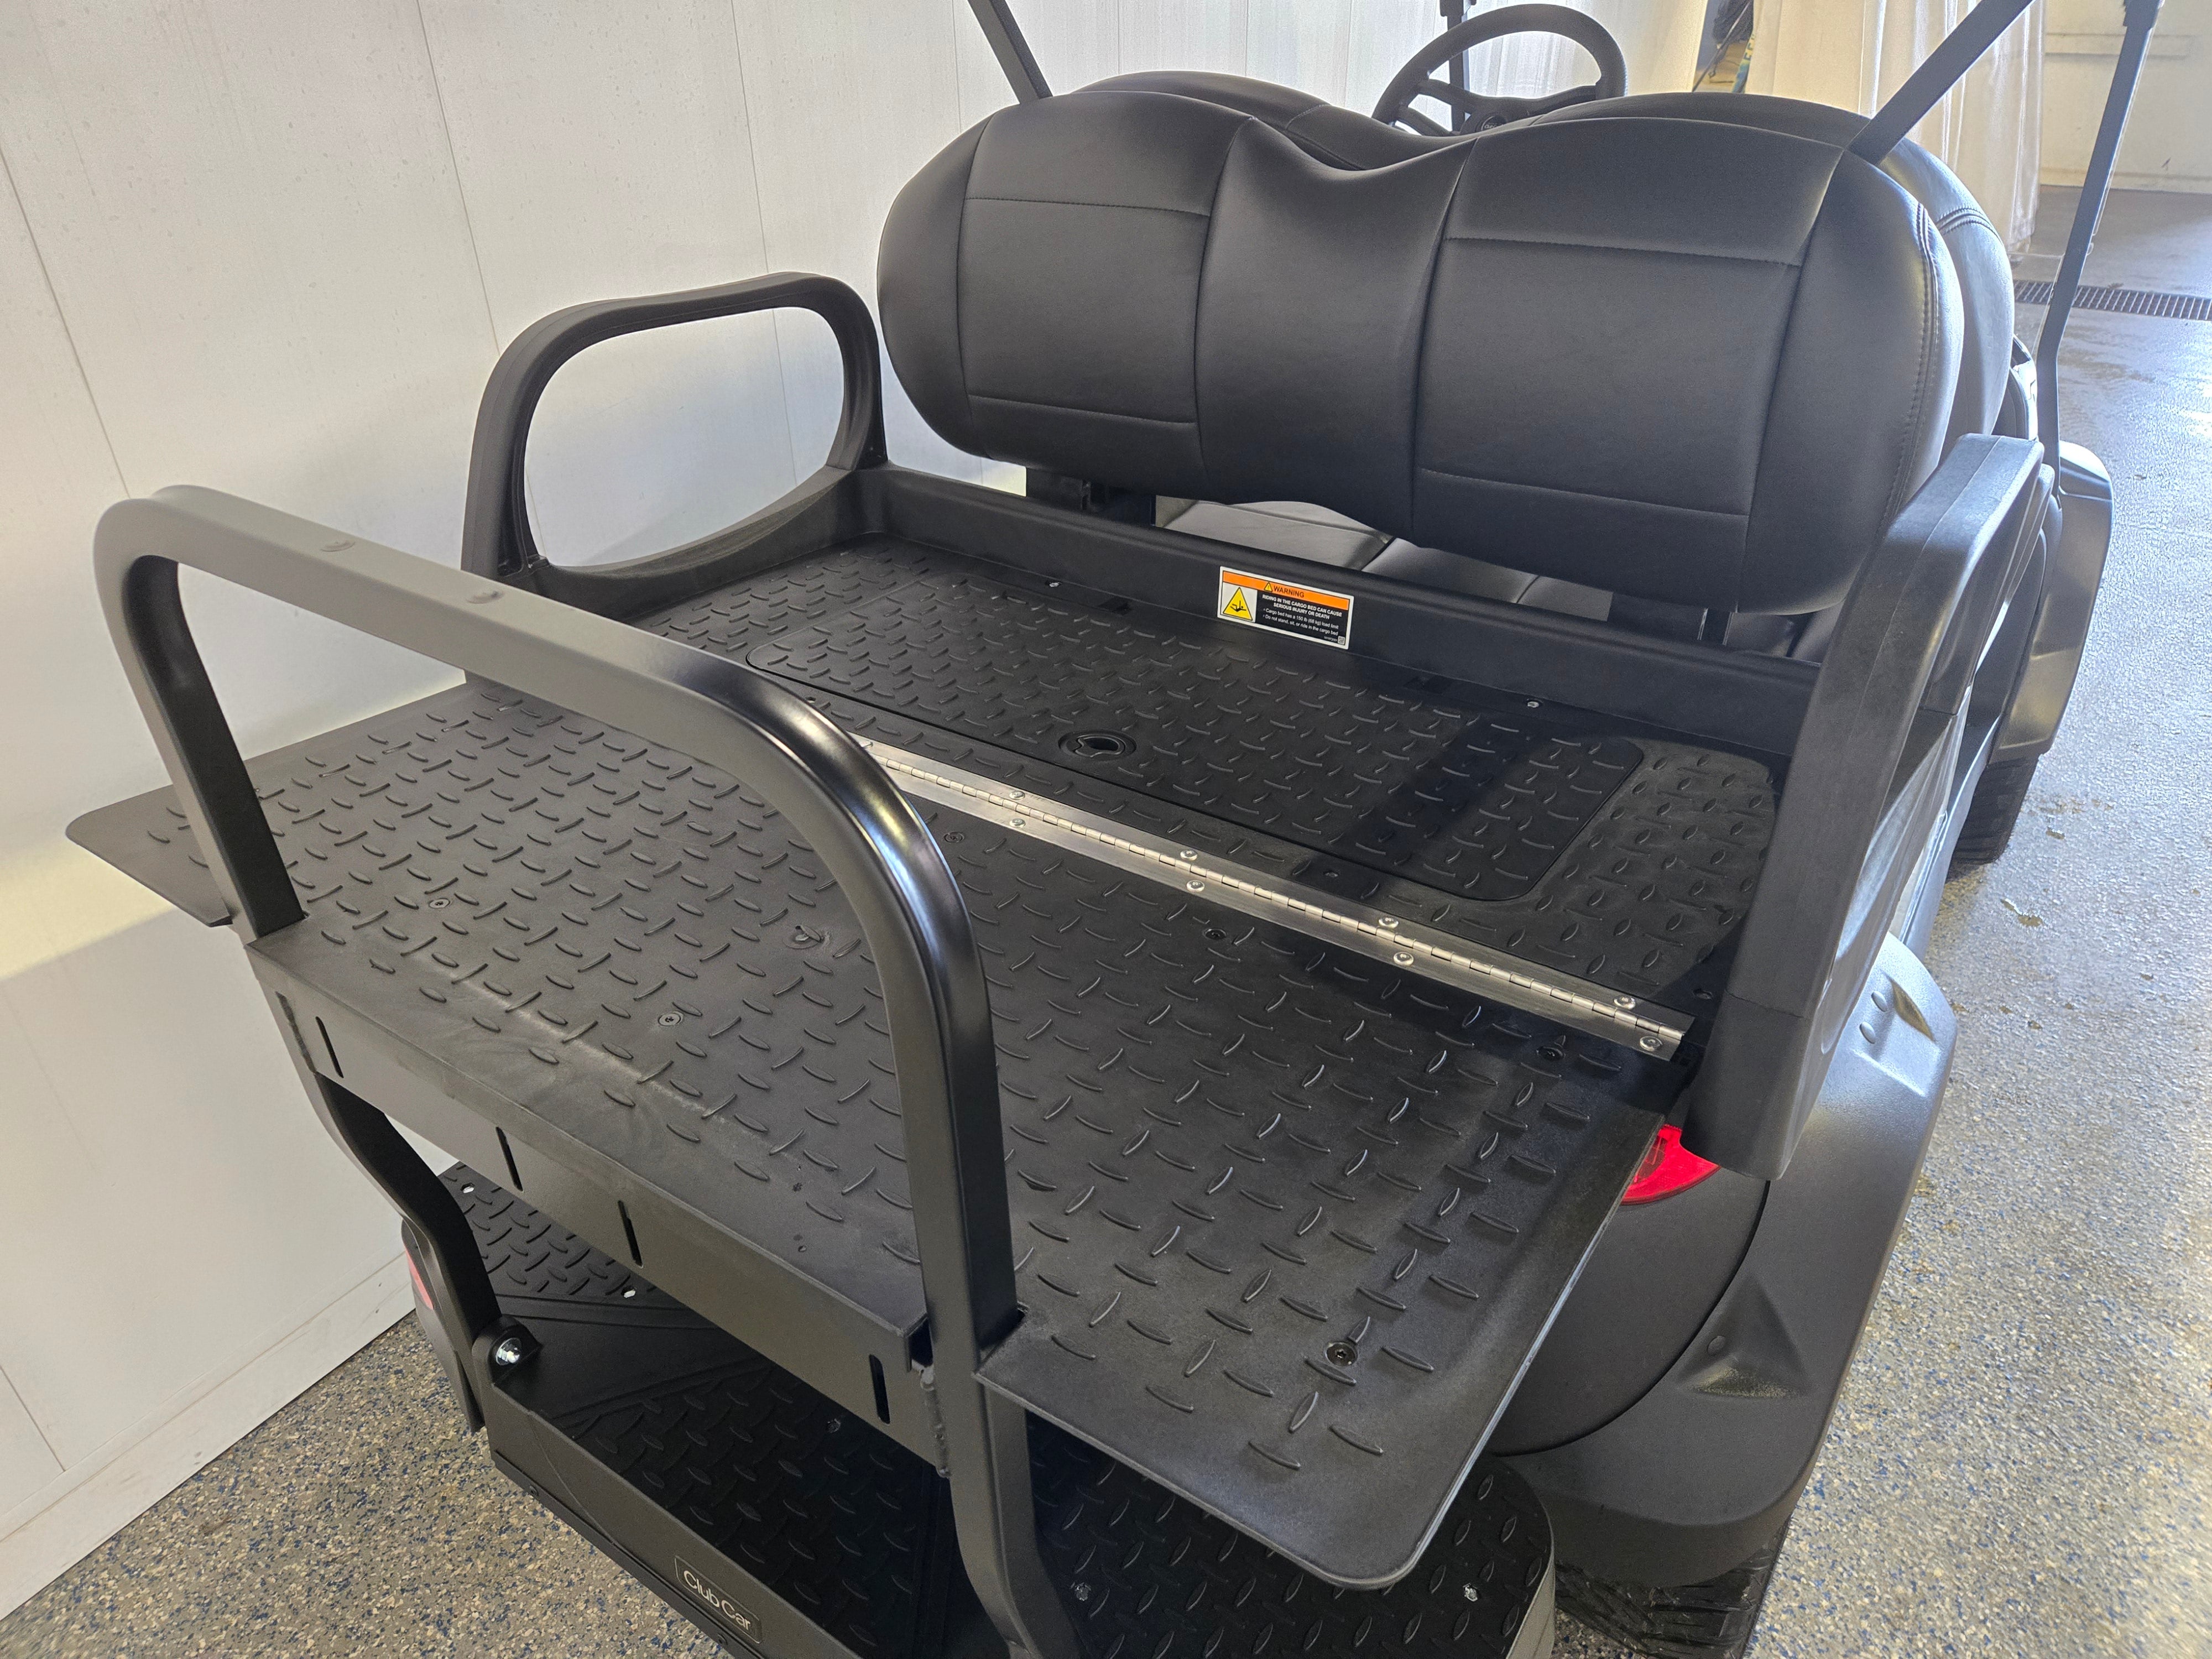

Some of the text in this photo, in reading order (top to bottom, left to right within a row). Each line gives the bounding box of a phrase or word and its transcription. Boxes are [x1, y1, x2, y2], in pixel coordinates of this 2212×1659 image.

[1274, 585, 1305, 598] WARNING
[1274, 602, 1292, 611] SERIOUS
[684, 1570, 751, 1630] Club Car
